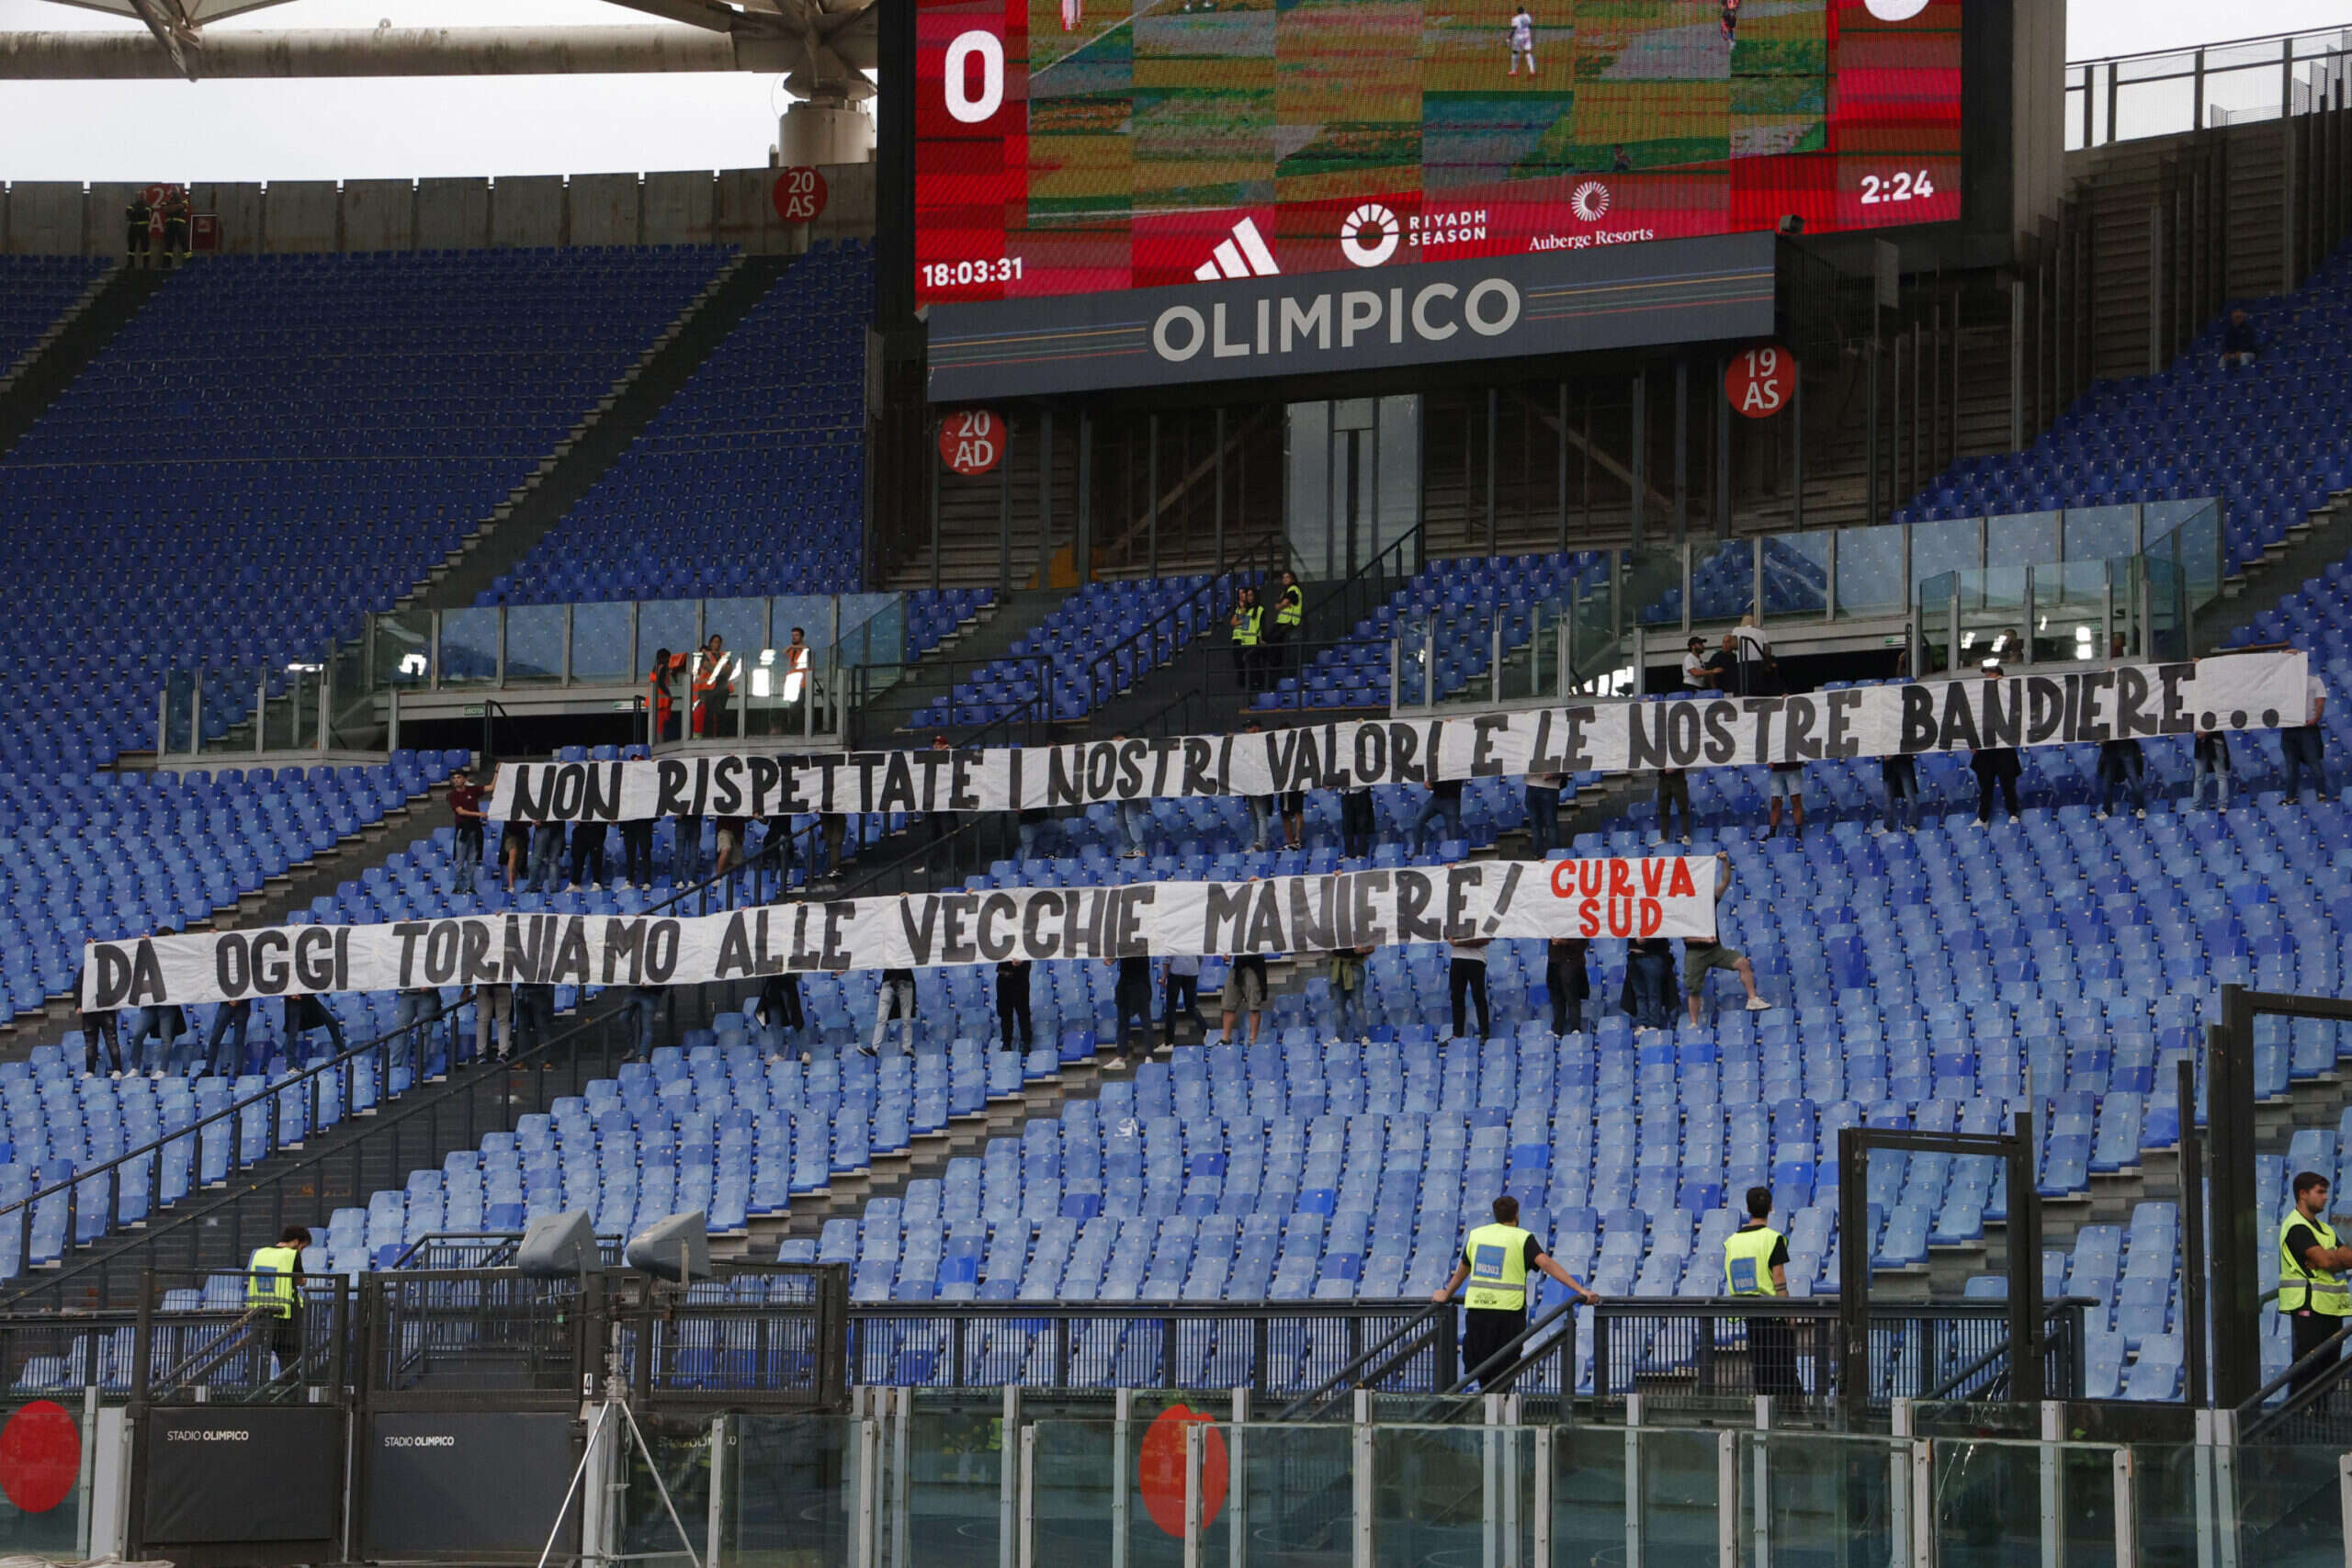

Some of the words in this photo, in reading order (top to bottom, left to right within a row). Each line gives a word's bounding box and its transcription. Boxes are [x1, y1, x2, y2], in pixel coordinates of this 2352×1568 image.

[944, 29, 1004, 123] 0
[787, 171, 815, 193] 20
[1860, 169, 1934, 205] 2:24
[786, 195, 816, 219] AS
[1408, 209, 1487, 230] RIYADH
[1408, 227, 1487, 246] SEASON
[1529, 233, 1591, 251] Auberge
[1595, 228, 1654, 246] Resorts
[922, 256, 1023, 288] 18:03:31
[1152, 276, 1521, 363] OLIMPICO
[1745, 347, 1777, 378] 19
[1742, 379, 1781, 412] AS
[958, 410, 991, 437] 20
[954, 440, 994, 468] AD
[511, 761, 624, 822] NON
[655, 750, 984, 818] RISPETTATE
[1010, 748, 1023, 810] I
[1046, 735, 1234, 806] NOSTRI
[1265, 720, 1444, 793] VALORI
[1469, 713, 1509, 777] E
[1529, 705, 1596, 773] LE
[1627, 688, 1863, 770] NOSTRE
[1550, 855, 1696, 898] CURVA
[1578, 897, 1663, 938] SUD
[94, 938, 168, 1010] DA
[215, 926, 352, 998] OGGI
[391, 914, 681, 987] TORNIAMO
[714, 900, 856, 979] ALLE
[899, 885, 1156, 965] VECCHIE
[1202, 862, 1525, 954] MANIERE!
[584, 1374, 592, 1394] 4
[166, 1430, 201, 1441] STADIO
[203, 1430, 249, 1441] OLIMPICO
[384, 1436, 413, 1448] STADIO
[414, 1436, 455, 1447] OLIMPICO
